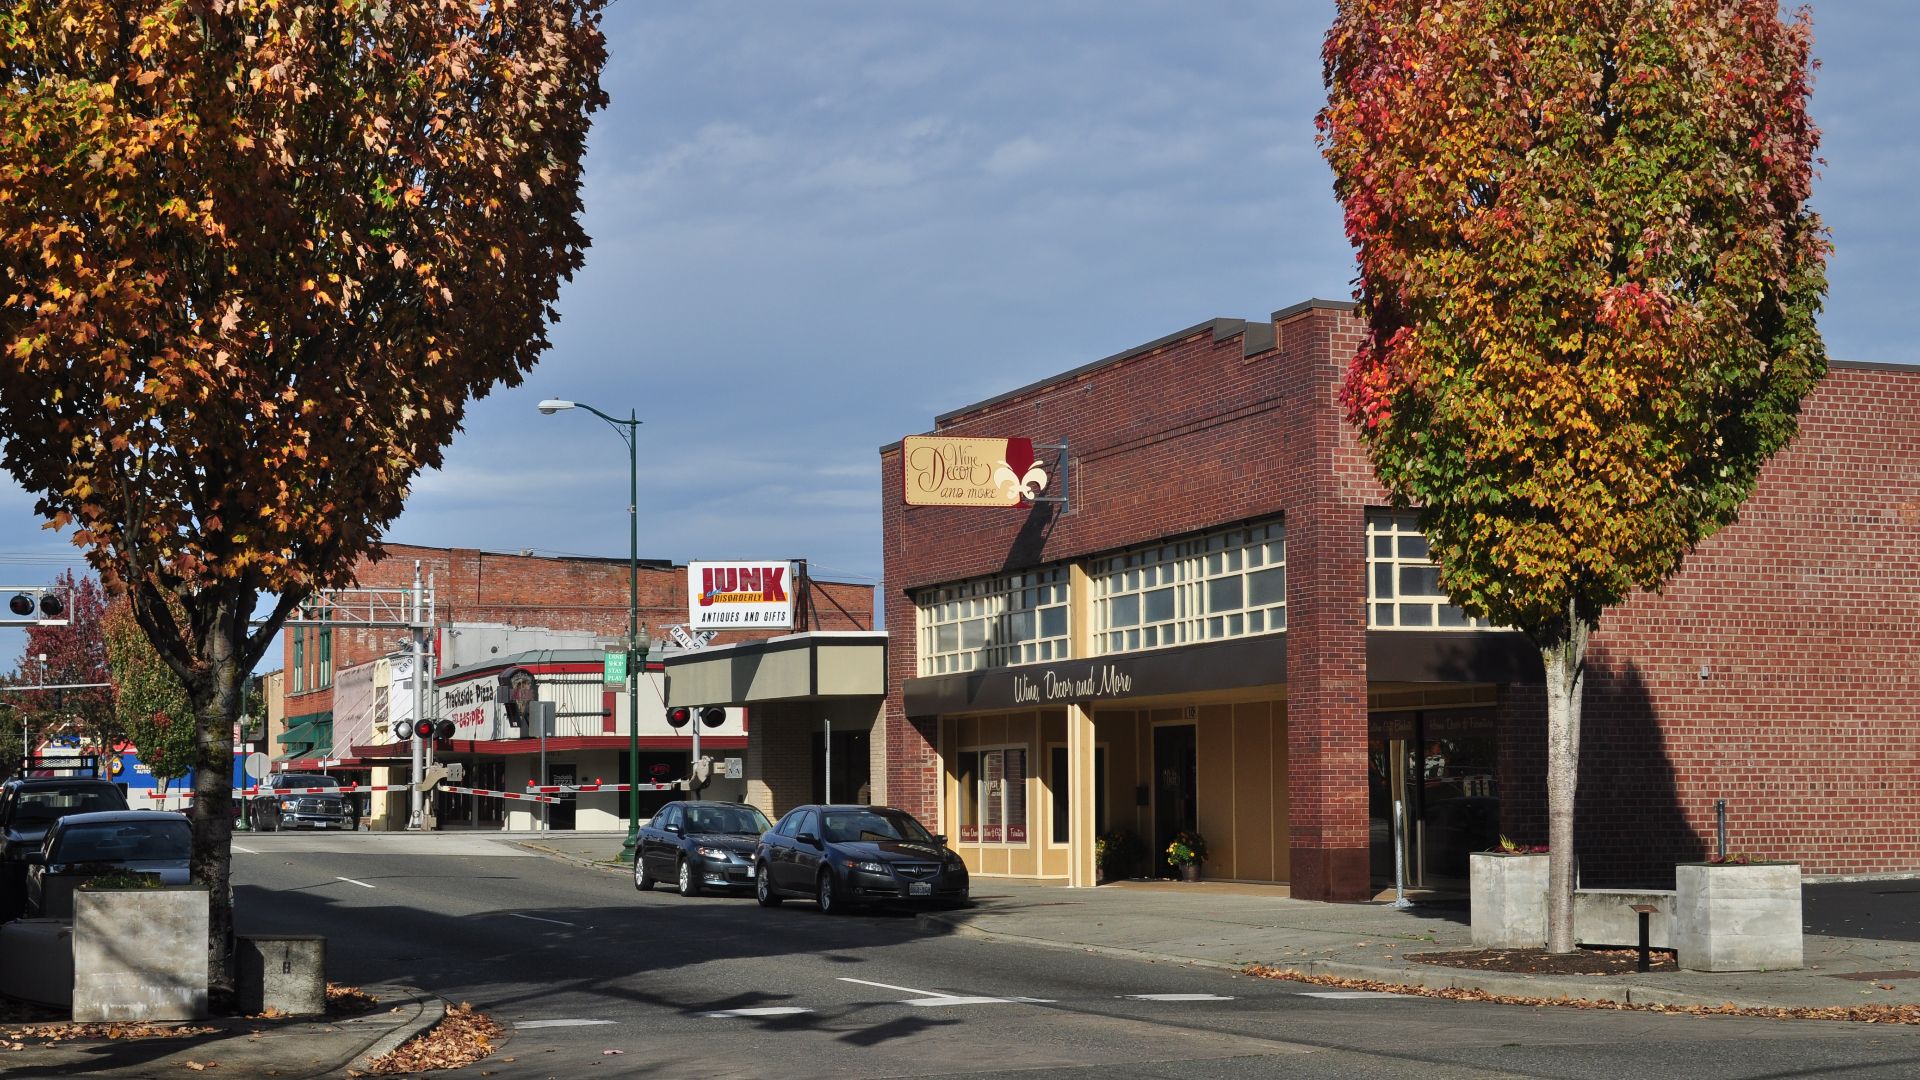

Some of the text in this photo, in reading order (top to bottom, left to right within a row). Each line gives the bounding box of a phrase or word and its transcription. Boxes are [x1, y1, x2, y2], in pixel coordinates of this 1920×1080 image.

[700, 567, 787, 607] JUNK
[714, 593, 762, 603] DISORDERLY
[701, 611, 786, 623] ANTIQUES AND GIFTS
[1014, 664, 1132, 703] Wine, Decor and More
[445, 684, 494, 709] Trackside Pizza
